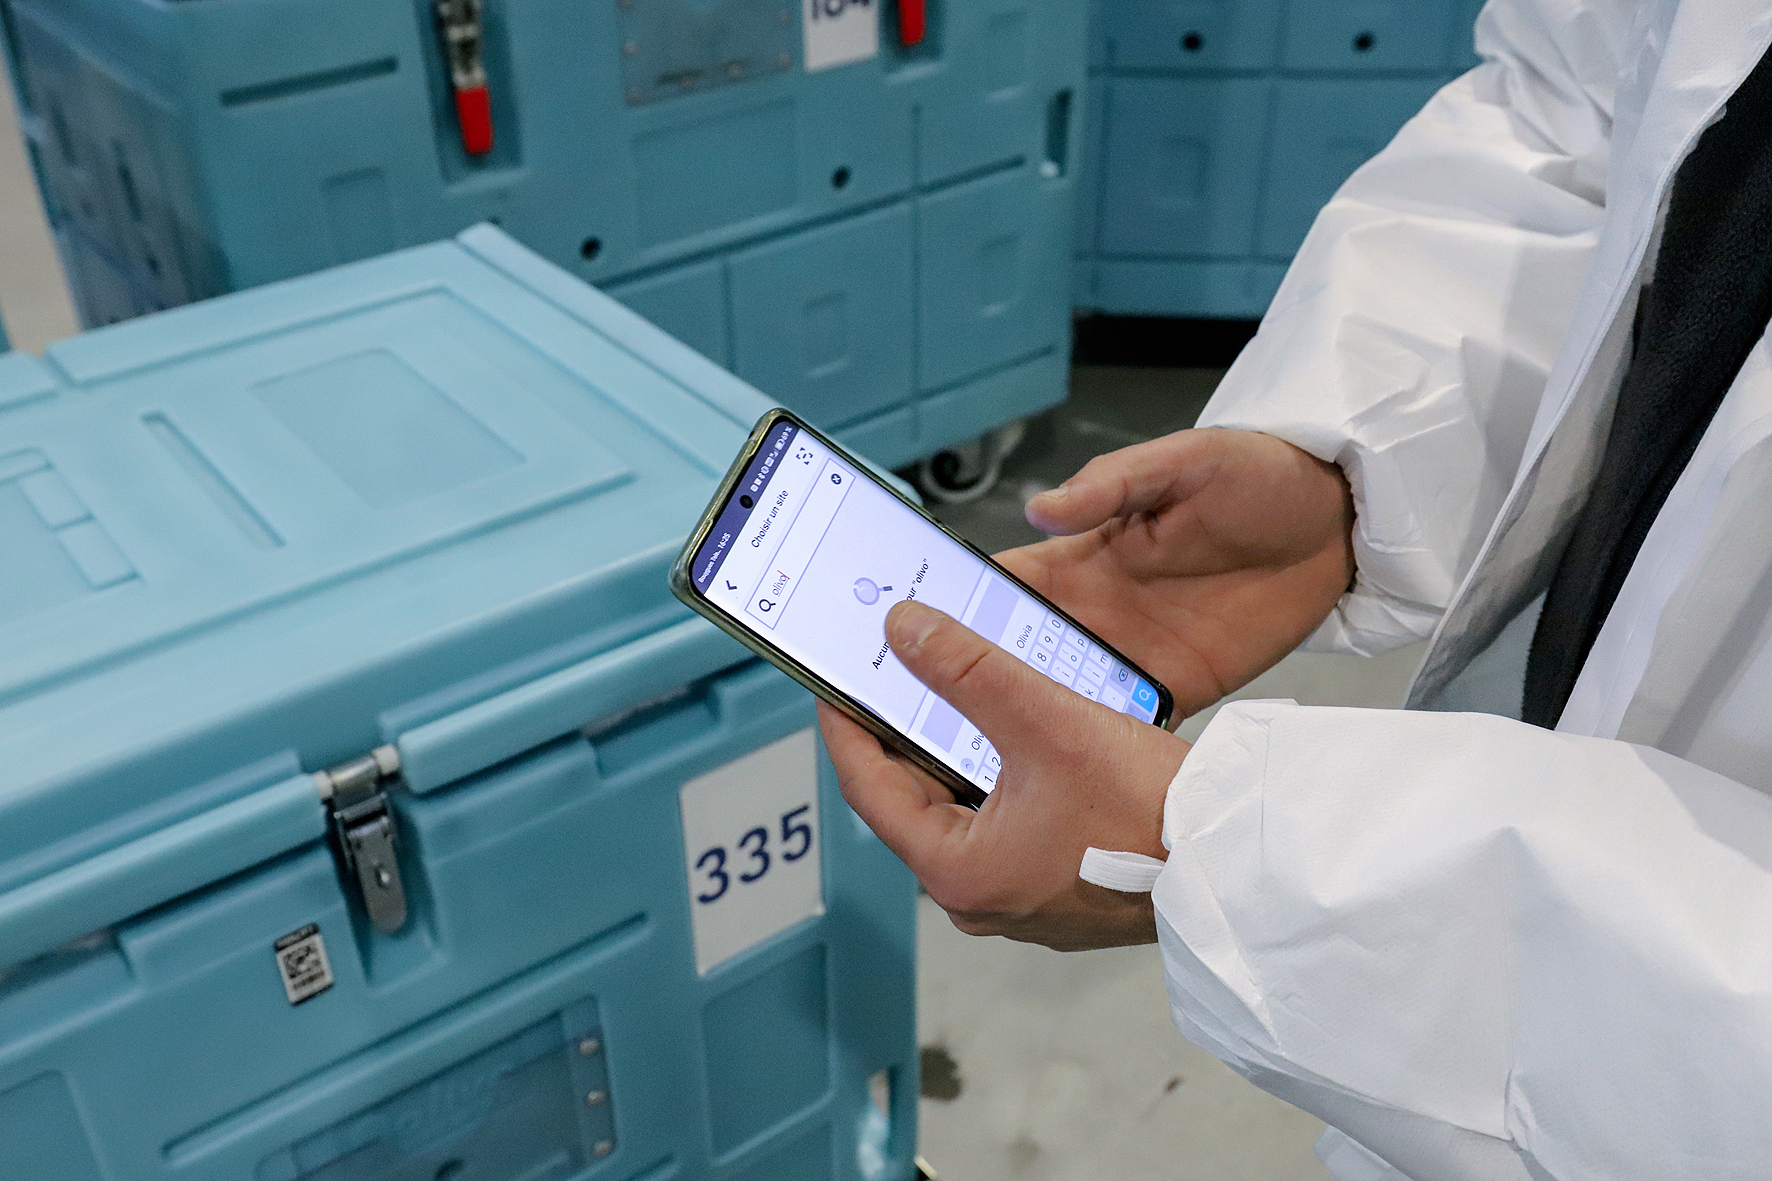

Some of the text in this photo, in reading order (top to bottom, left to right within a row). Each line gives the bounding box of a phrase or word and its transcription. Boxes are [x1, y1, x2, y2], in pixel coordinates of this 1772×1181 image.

[751, 490, 789, 548] Choisir un site
[772, 574, 787, 596] olivo
[906, 586, 917, 601] our
[912, 557, 929, 585] "olivo"
[1016, 624, 1033, 649] Olivia
[1070, 654, 1078, 662] o
[1077, 638, 1085, 648] p
[1084, 689, 1094, 697] k
[1100, 653, 1109, 665] m
[984, 619, 1061, 783] 1 2 8 9 0
[971, 732, 985, 751] Oliv
[696, 804, 811, 904] 335
